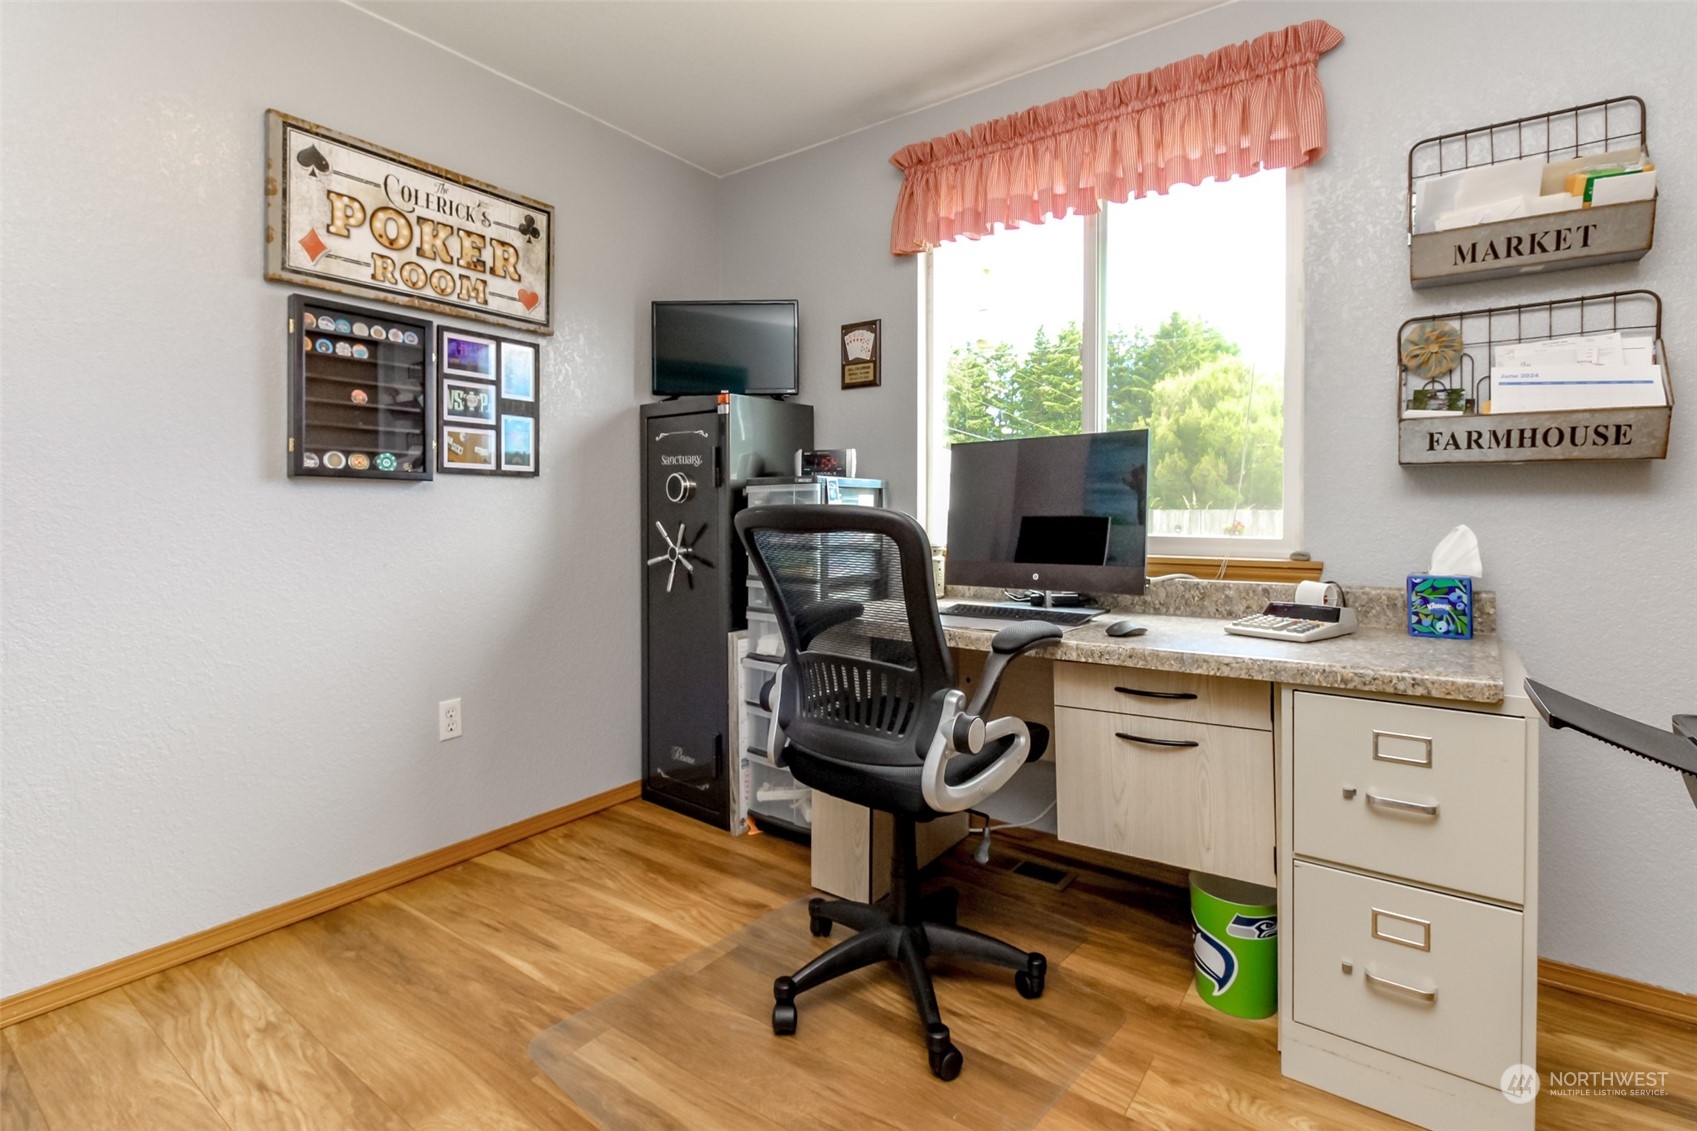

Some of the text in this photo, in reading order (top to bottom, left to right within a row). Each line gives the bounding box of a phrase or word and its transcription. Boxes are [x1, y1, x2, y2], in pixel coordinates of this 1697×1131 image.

[434, 182, 449, 195] The
[326, 189, 522, 282] POKER
[1453, 224, 1598, 266] MARKET
[371, 252, 488, 305] ROOM
[1427, 423, 1633, 451] FARMHOUSE
